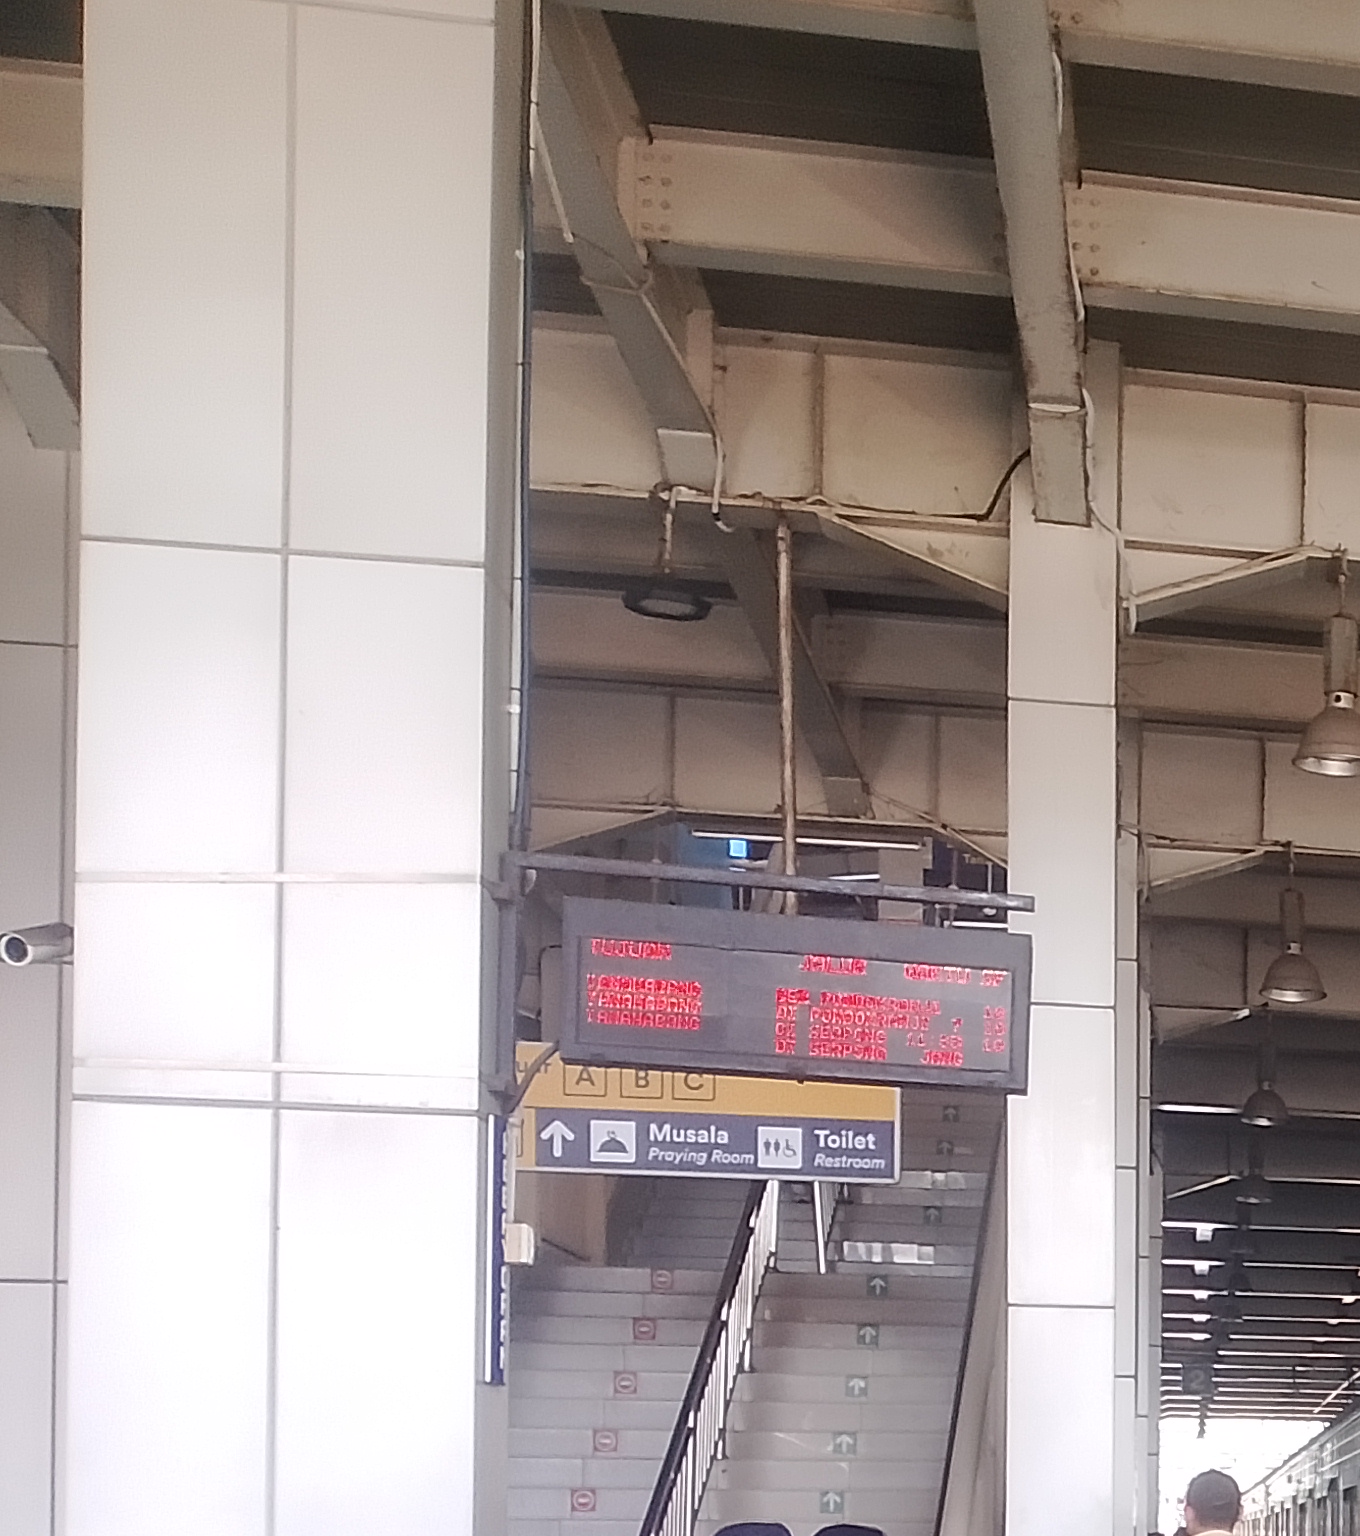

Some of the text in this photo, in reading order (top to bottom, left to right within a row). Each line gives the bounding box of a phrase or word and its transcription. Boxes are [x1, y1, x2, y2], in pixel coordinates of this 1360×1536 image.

[591, 938, 672, 961] TUJUAN
[808, 1042, 888, 1061] SERPONG
[575, 1067, 595, 1087] A
[635, 1069, 649, 1088] B
[683, 1072, 704, 1091] C
[649, 1123, 729, 1144] Musala
[814, 1129, 876, 1150] Toilet
[648, 1147, 755, 1165] Praying Room
[814, 1153, 885, 1170] Restroom
